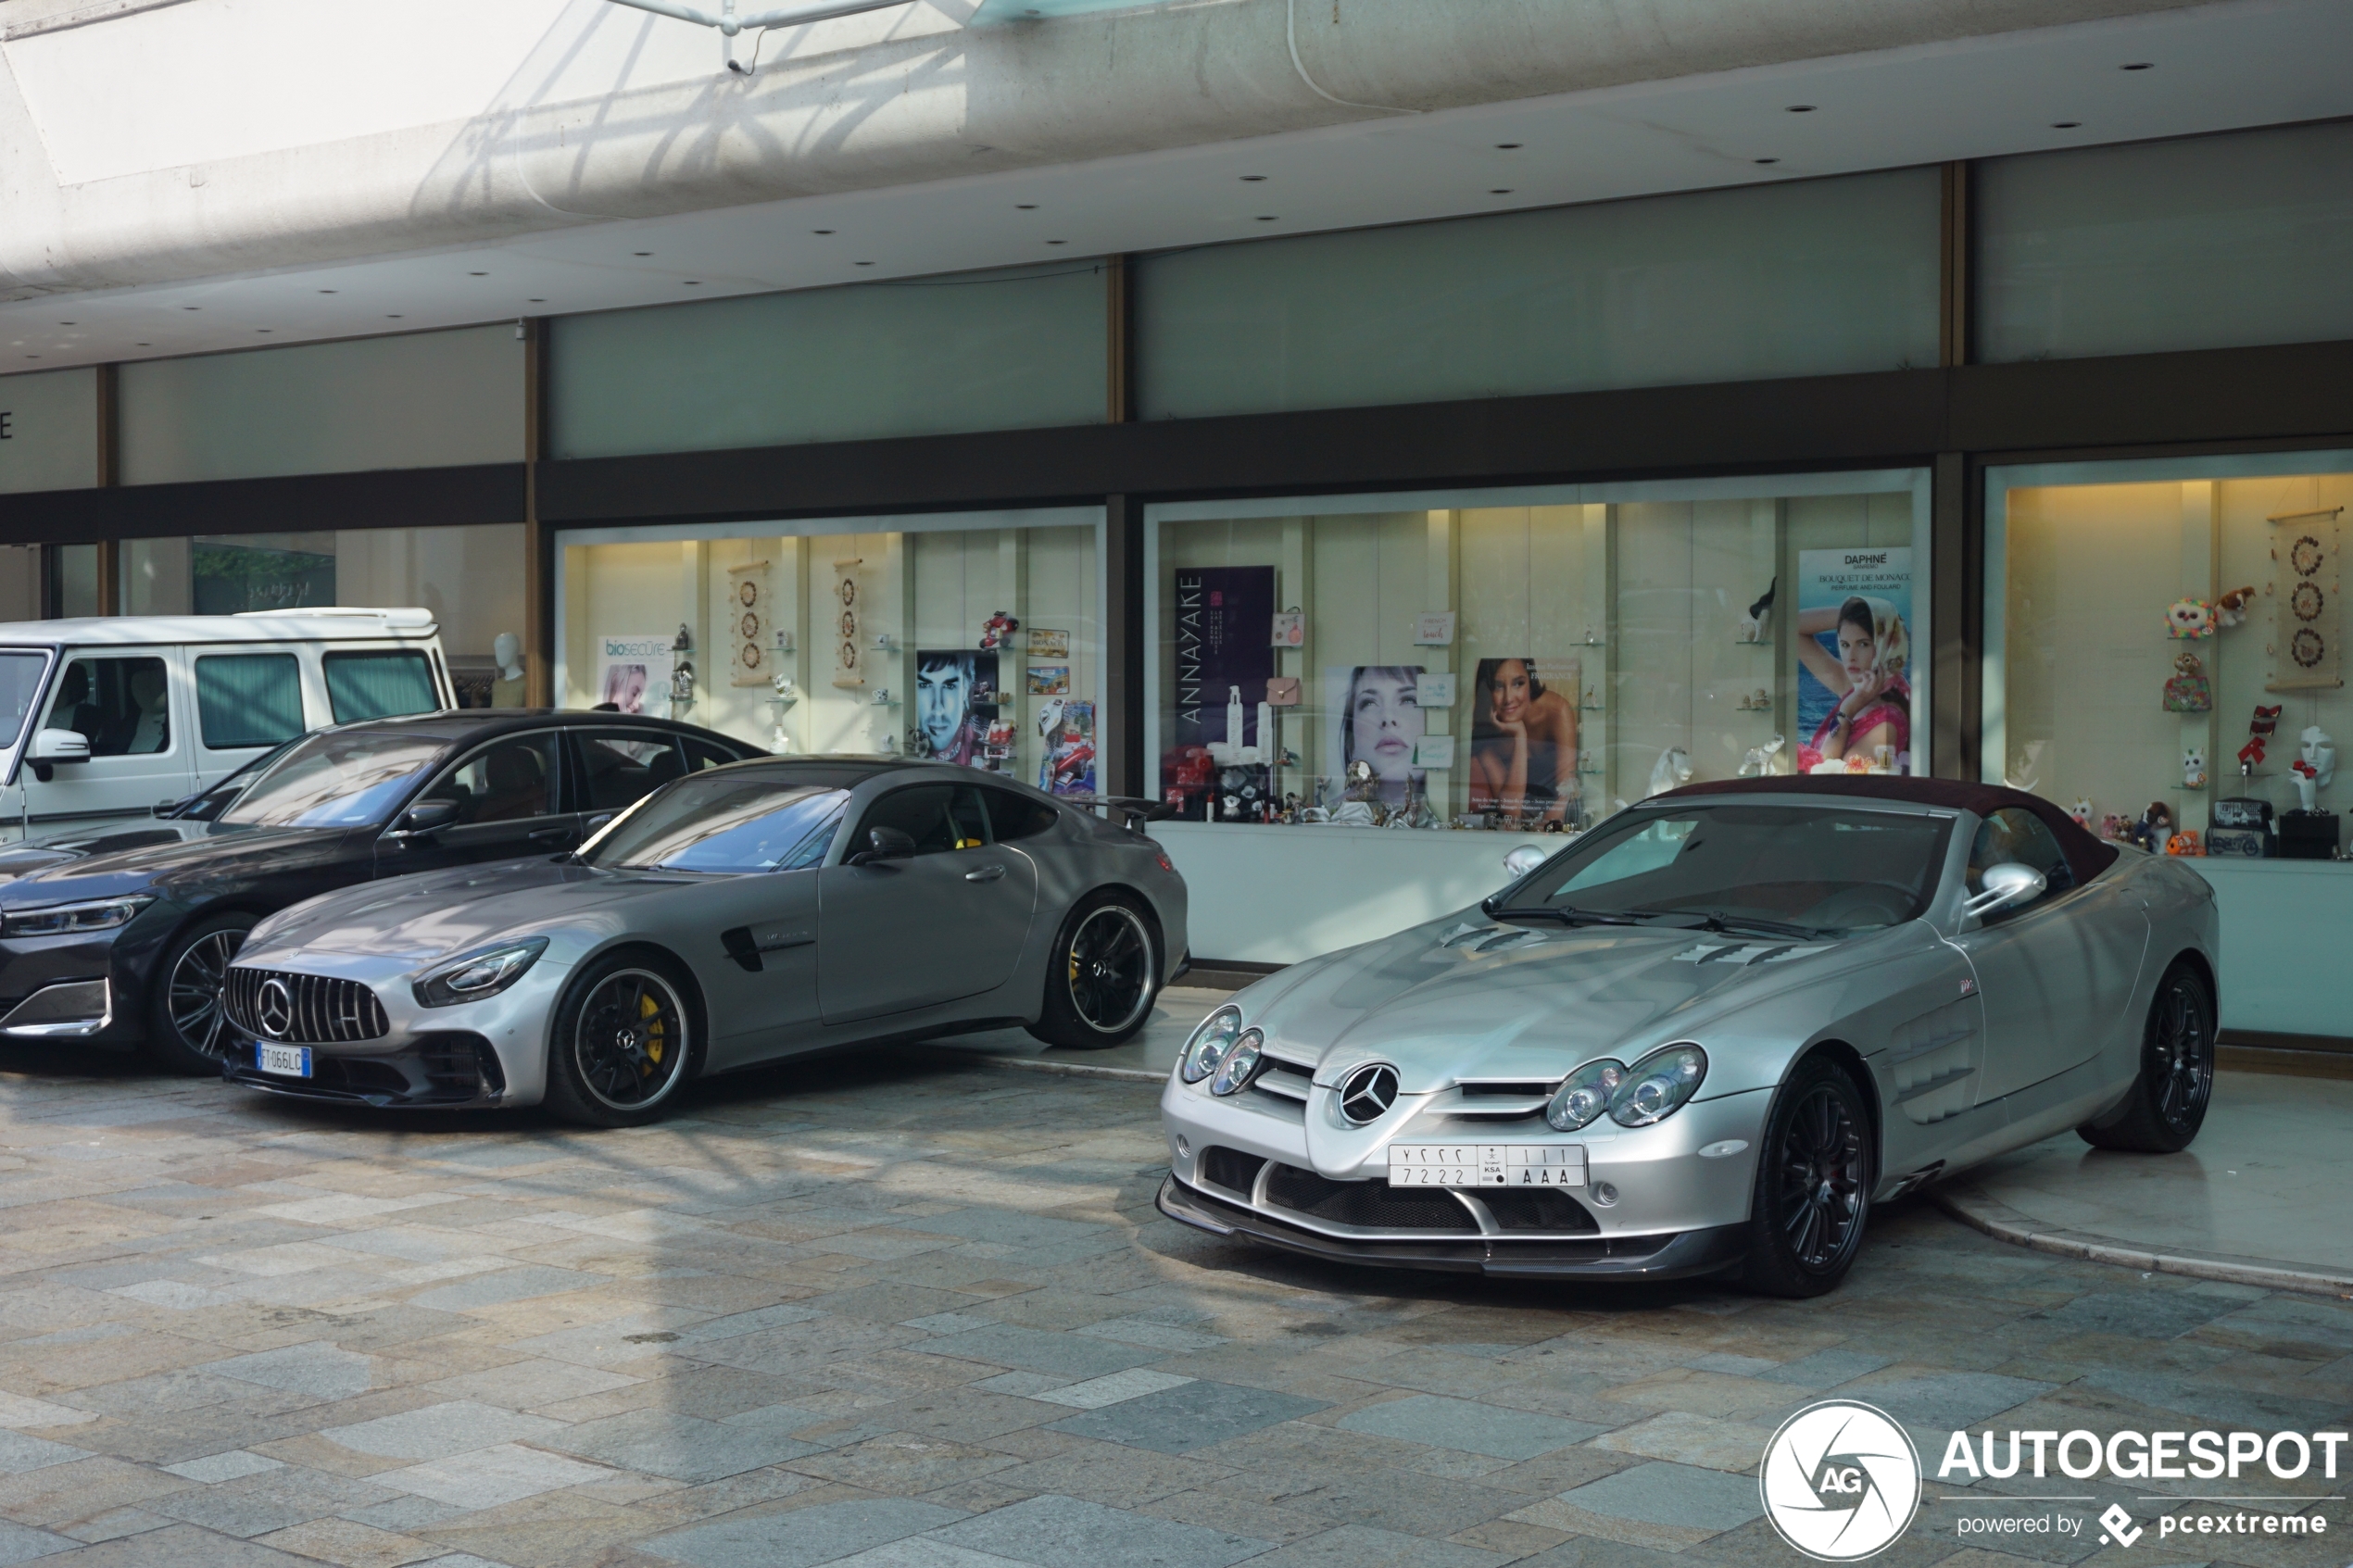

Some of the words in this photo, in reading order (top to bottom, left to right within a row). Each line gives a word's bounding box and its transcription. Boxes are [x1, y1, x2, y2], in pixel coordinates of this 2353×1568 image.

[0, 411, 12, 439] E
[1844, 552, 1887, 564] DAPHNÉ
[1818, 574, 1860, 583] BOUQUET
[1180, 576, 1202, 724] ANNAYAKE
[1530, 671, 1572, 680] FRAGRANCE
[1403, 1168, 1464, 1185] 7222
[1523, 1169, 1568, 1184] AAA
